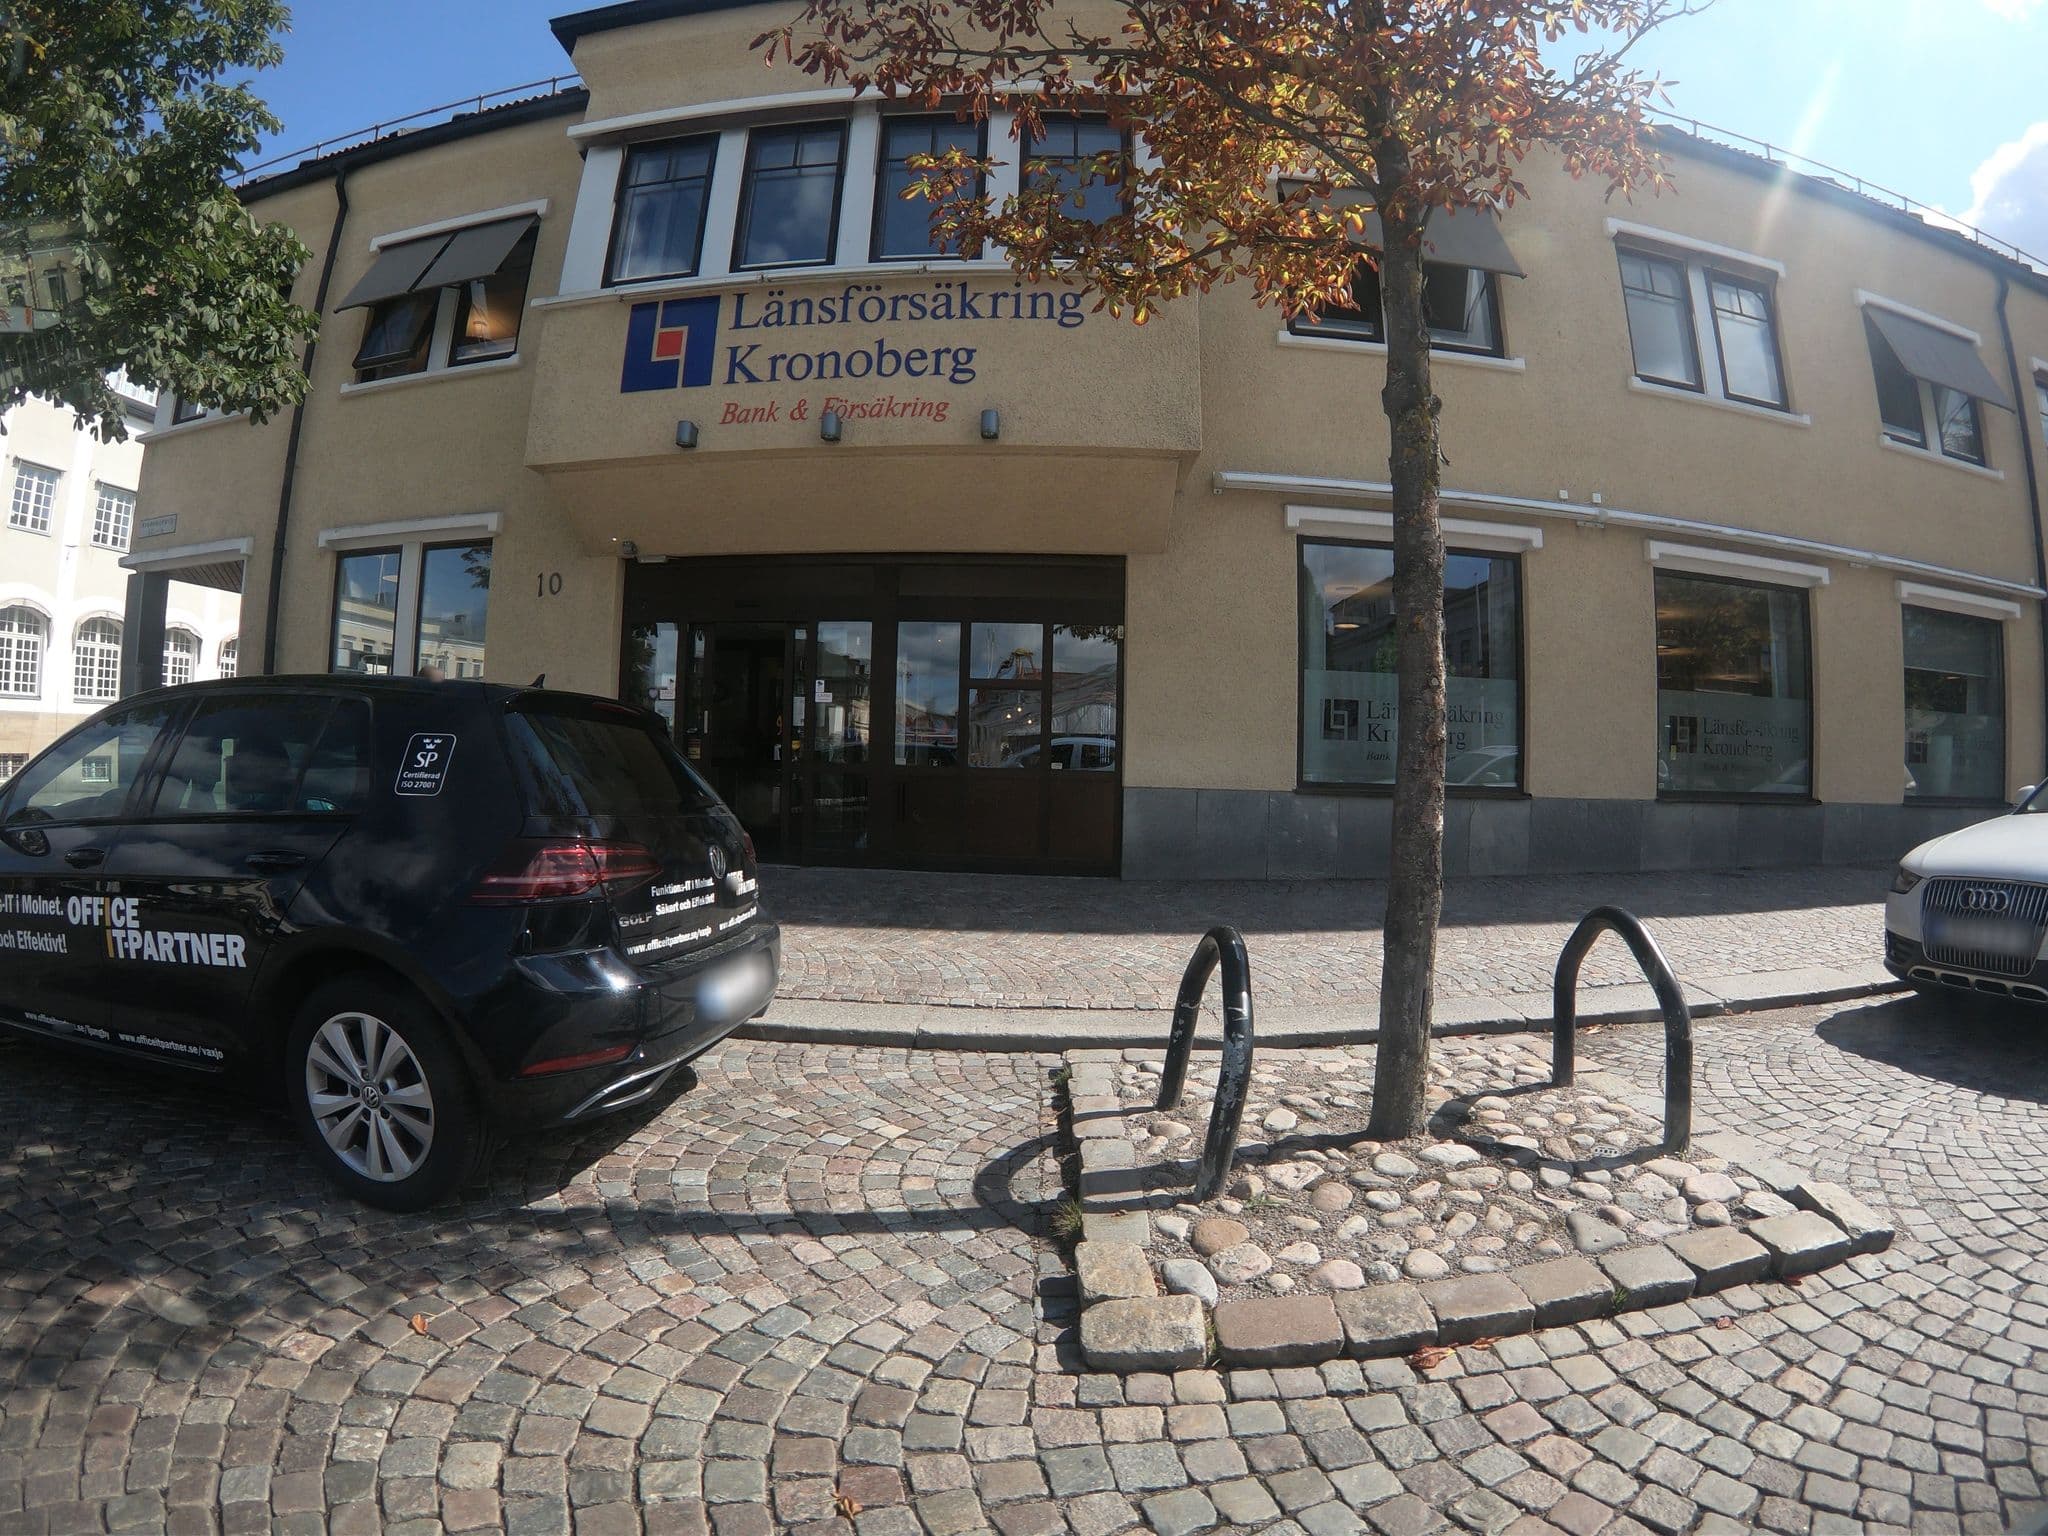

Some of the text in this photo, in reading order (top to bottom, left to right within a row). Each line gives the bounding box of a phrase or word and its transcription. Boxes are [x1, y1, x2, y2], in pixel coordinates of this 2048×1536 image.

[728, 281, 1085, 331] Länsförsäkring
[723, 338, 977, 386] Kronoberg
[720, 395, 950, 424] Bank & Försäkring
[536, 572, 562, 598] 10
[414, 751, 438, 768] SP
[403, 771, 440, 779] Certifierad
[67, 896, 140, 928] OFFICE
[619, 912, 653, 927] GOLF
